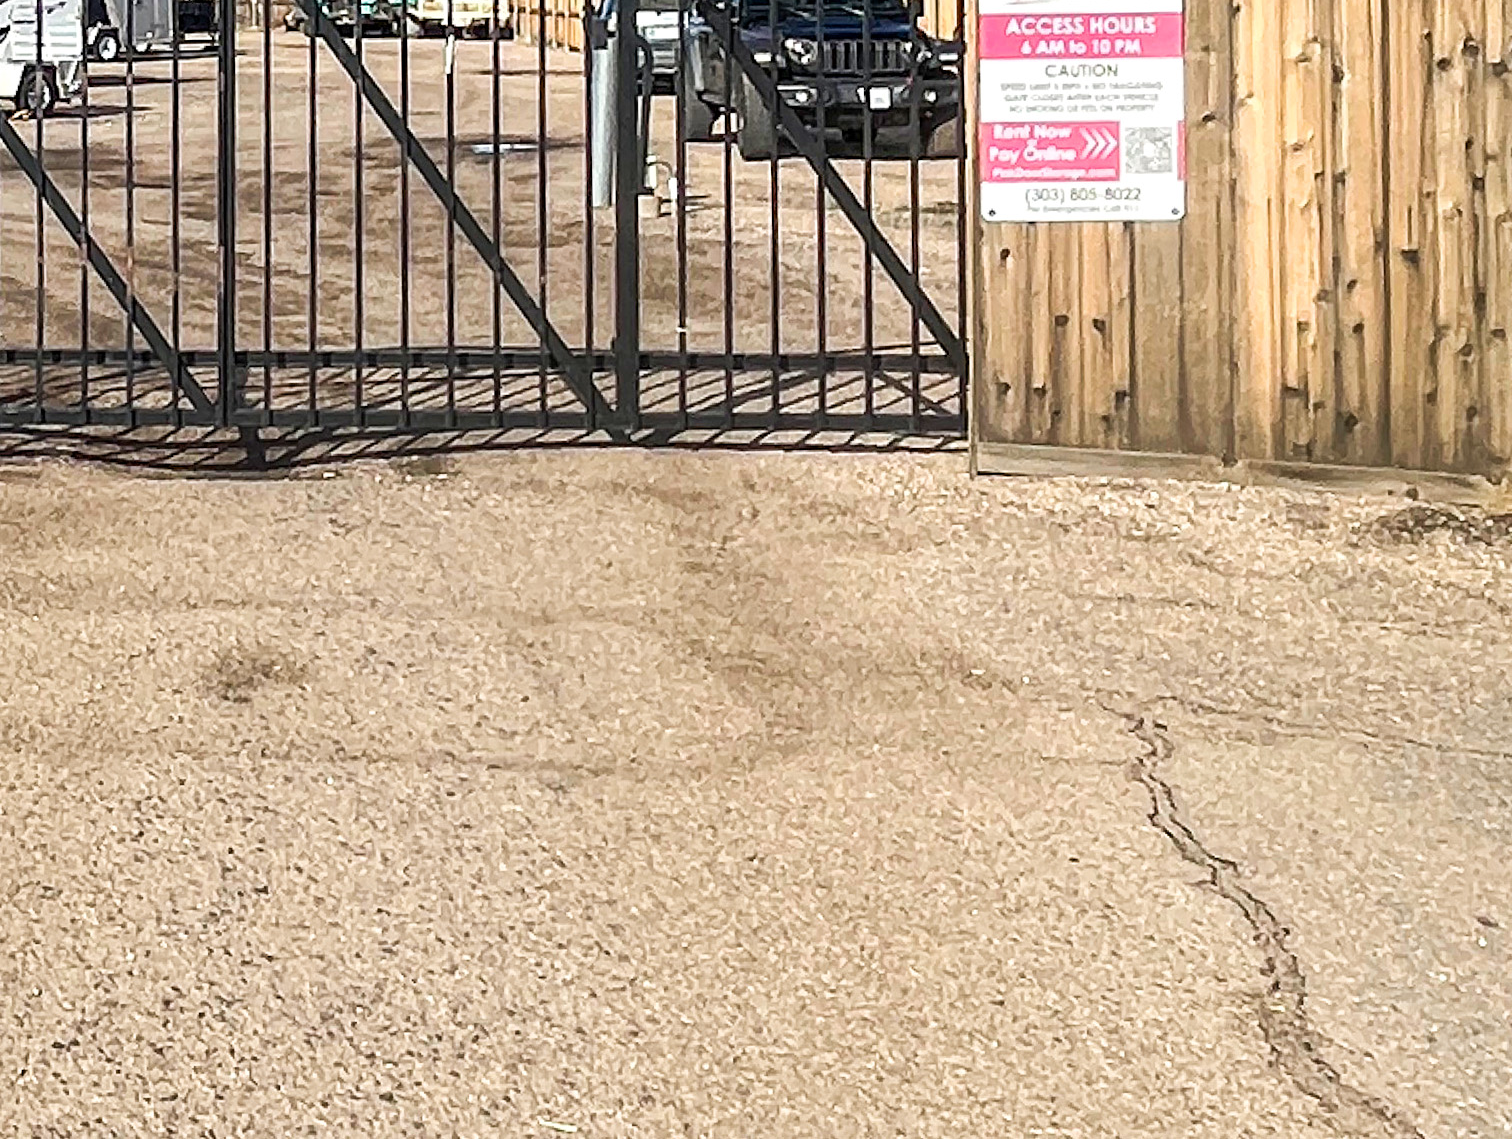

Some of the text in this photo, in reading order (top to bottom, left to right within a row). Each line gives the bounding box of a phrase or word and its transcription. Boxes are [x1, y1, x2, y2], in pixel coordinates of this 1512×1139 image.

[1005, 15, 1157, 35] ACCESS HOURS
[1021, 39, 1143, 55] 6 AM to 10 PM
[1045, 64, 1119, 77] CAUTION
[993, 124, 1072, 139] Rent Now
[989, 145, 1077, 165] Pay Online
[1025, 187, 1065, 204] (303)
